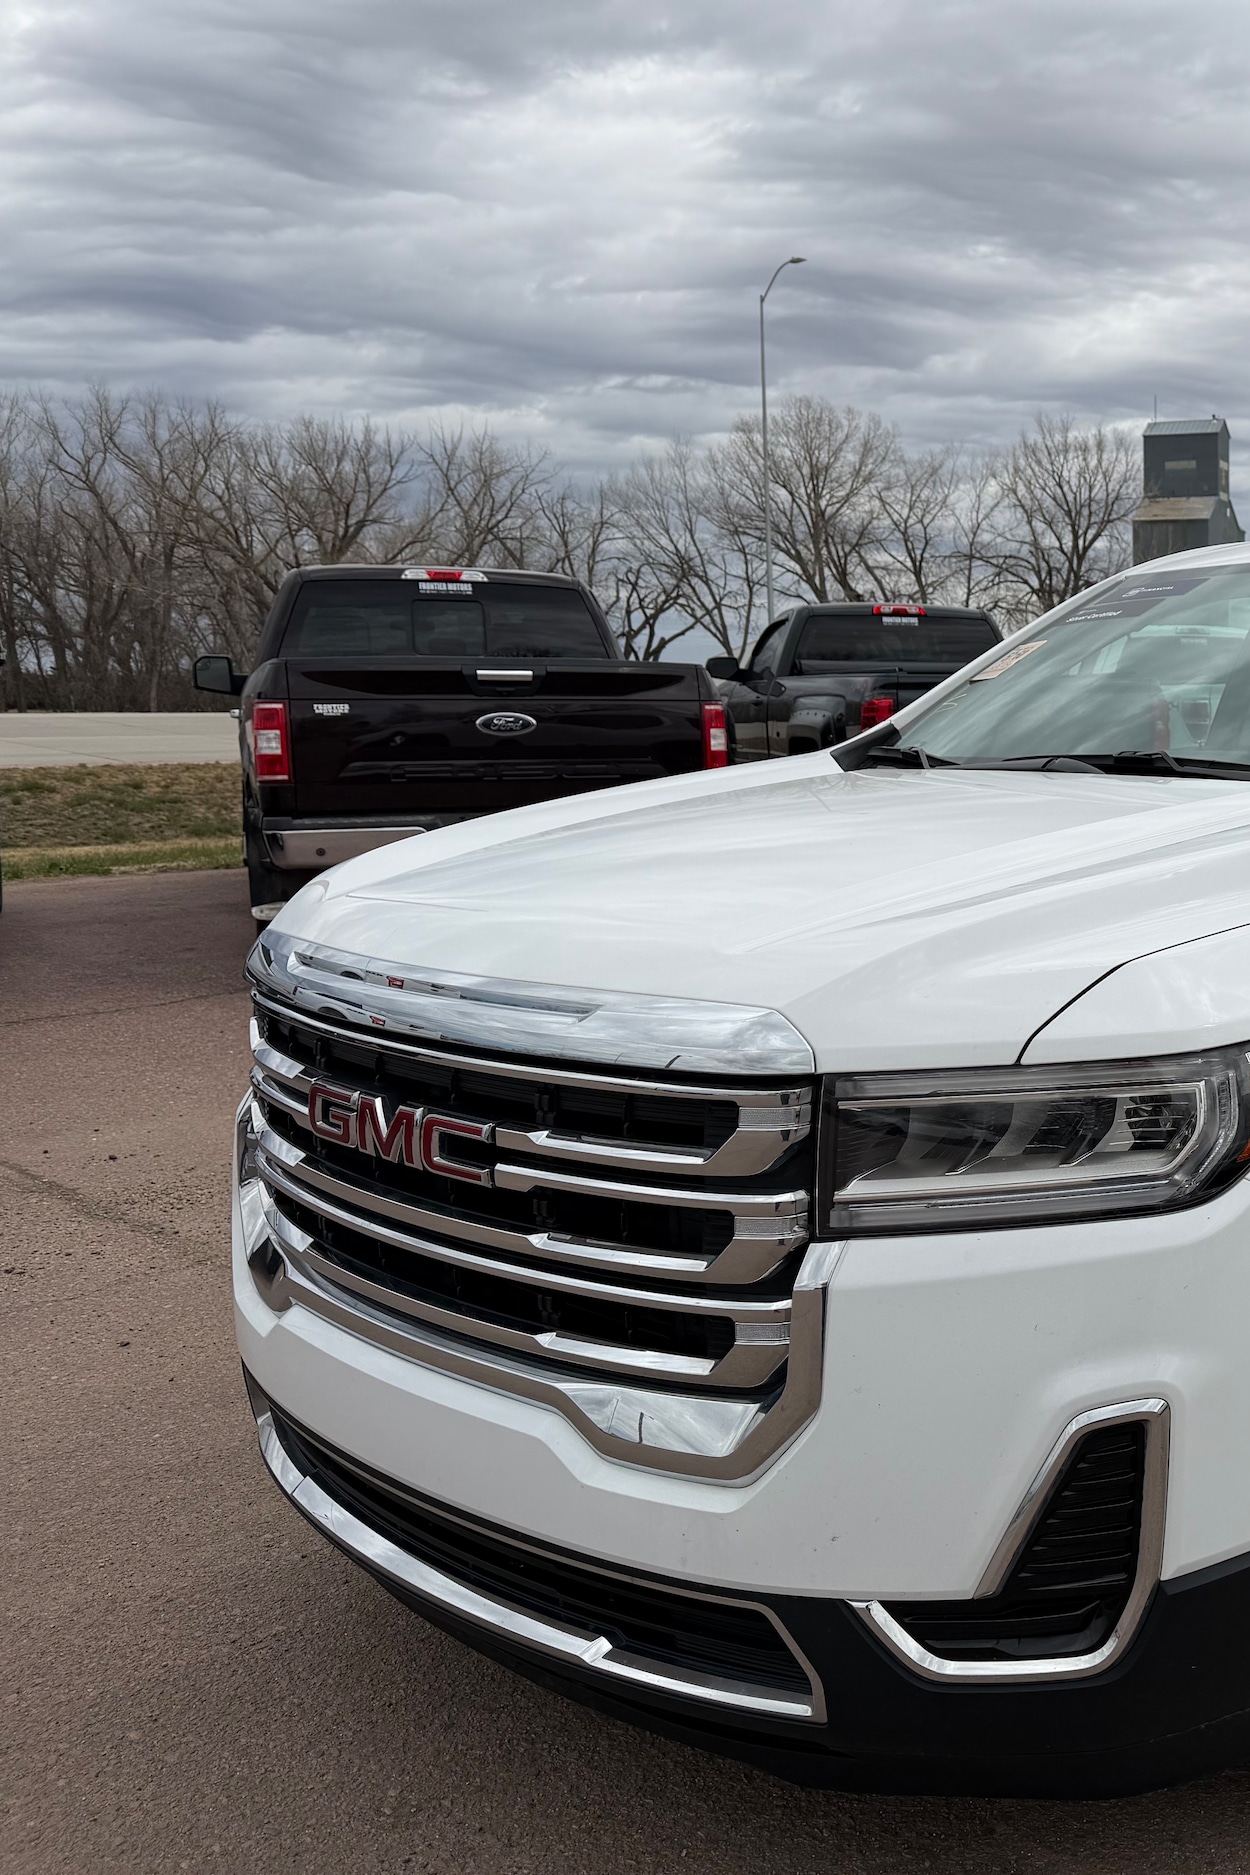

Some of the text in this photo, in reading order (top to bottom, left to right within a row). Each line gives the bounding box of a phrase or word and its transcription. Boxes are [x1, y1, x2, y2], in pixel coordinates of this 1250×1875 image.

[418, 582, 472, 591] FRONTIER MOTORS
[490, 716, 523, 731] Ford
[308, 1080, 494, 1189] GMC
